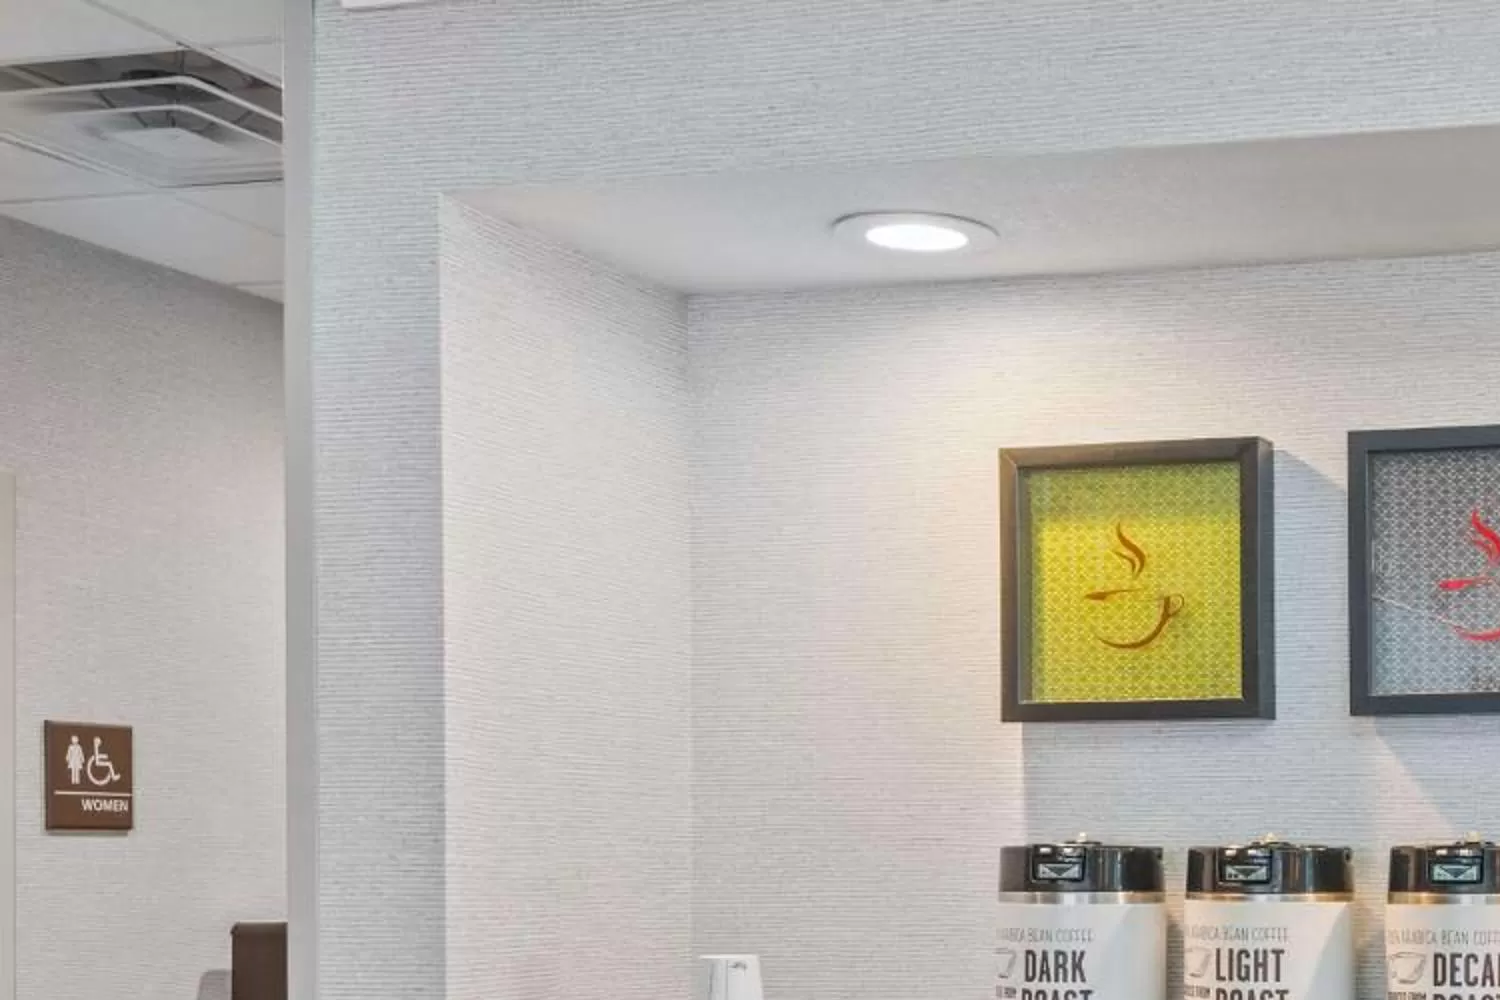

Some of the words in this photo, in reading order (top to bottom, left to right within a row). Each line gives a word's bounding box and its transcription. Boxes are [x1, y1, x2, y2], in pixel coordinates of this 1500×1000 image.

[81, 798, 129, 812] WOMEN
[1025, 949, 1087, 983] DARK
[1215, 947, 1285, 982] LIGHT
